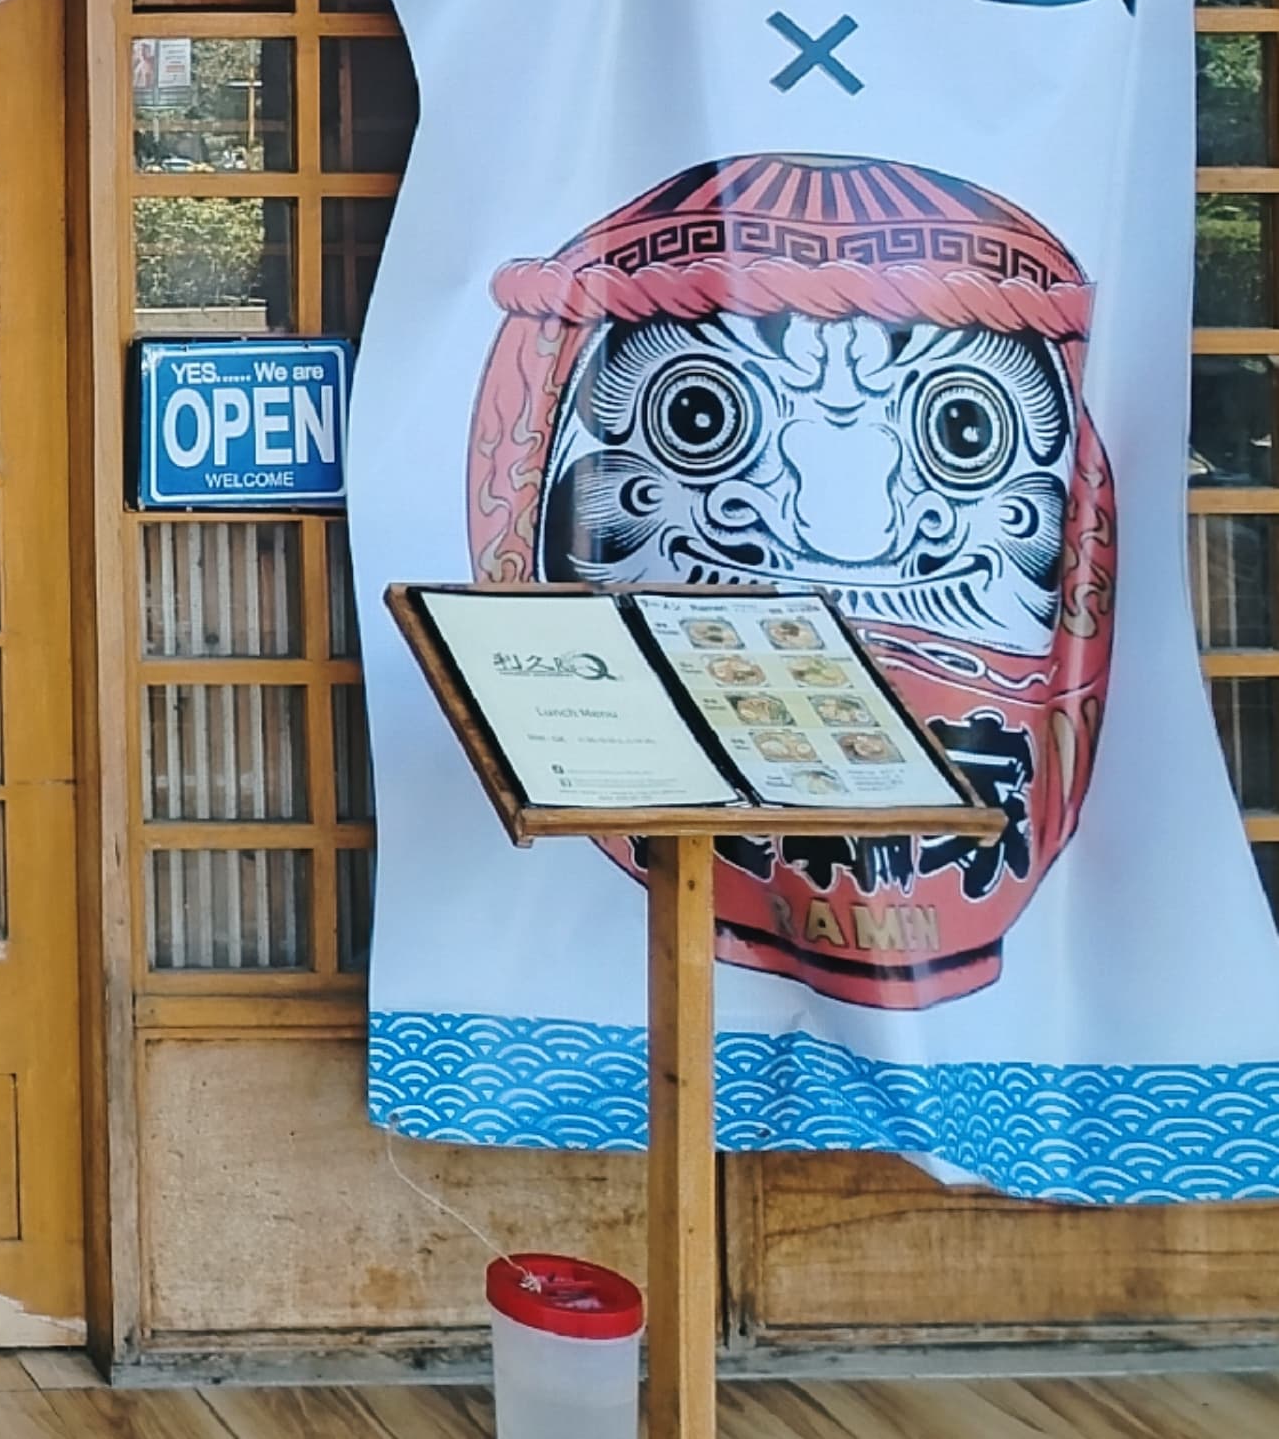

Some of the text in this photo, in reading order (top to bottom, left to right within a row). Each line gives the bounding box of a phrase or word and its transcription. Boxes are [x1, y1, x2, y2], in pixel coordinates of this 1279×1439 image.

[254, 362, 287, 382] We
[292, 364, 324, 381] are
[163, 385, 335, 468] OPEN
[205, 472, 294, 488] WELCOME
[536, 707, 618, 719] Lunch Menu
[771, 895, 939, 952] RAMEN
